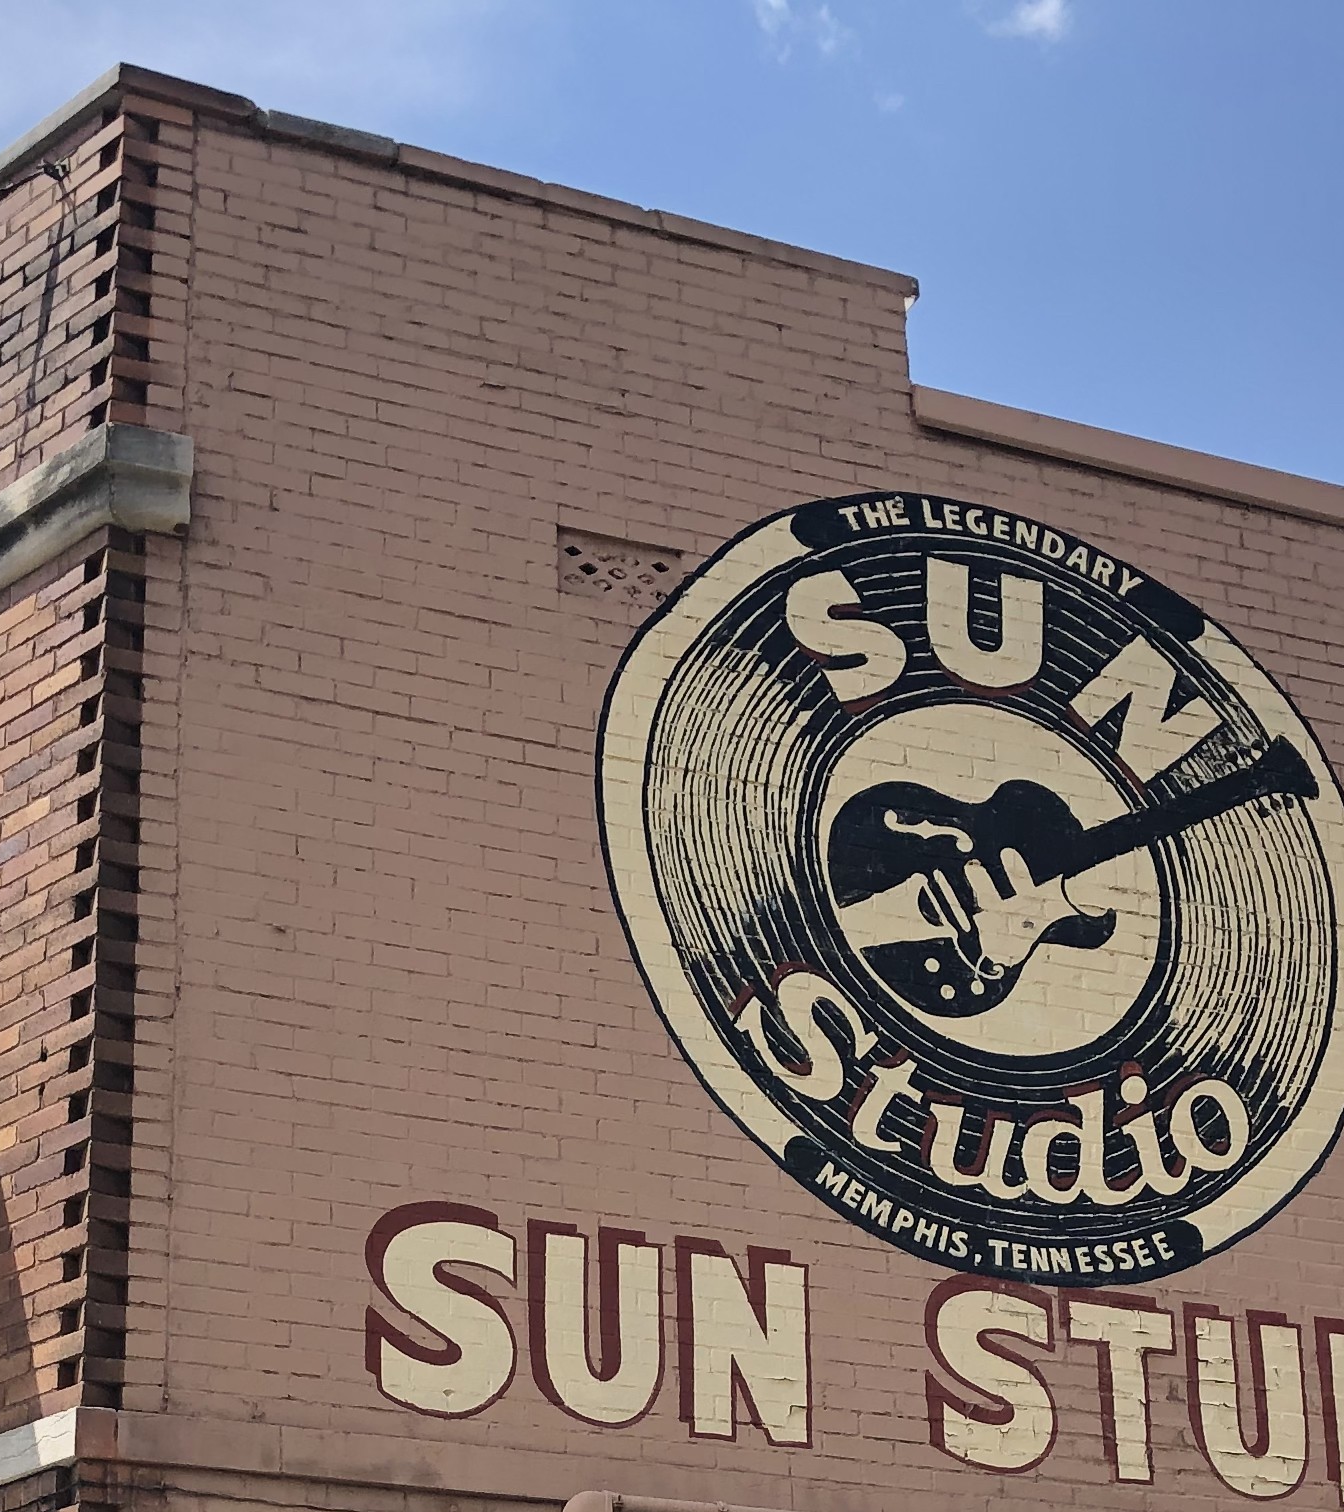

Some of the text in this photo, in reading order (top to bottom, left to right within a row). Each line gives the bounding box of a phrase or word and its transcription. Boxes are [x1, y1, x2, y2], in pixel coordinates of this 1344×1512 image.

[837, 495, 1145, 599] THE LEGENDARY
[786, 557, 1231, 788] SUN
[731, 961, 1251, 1206] Studio
[364, 1197, 814, 1450] SUN
[814, 1160, 1176, 1276] MEMPHIS, TENNESSEE
